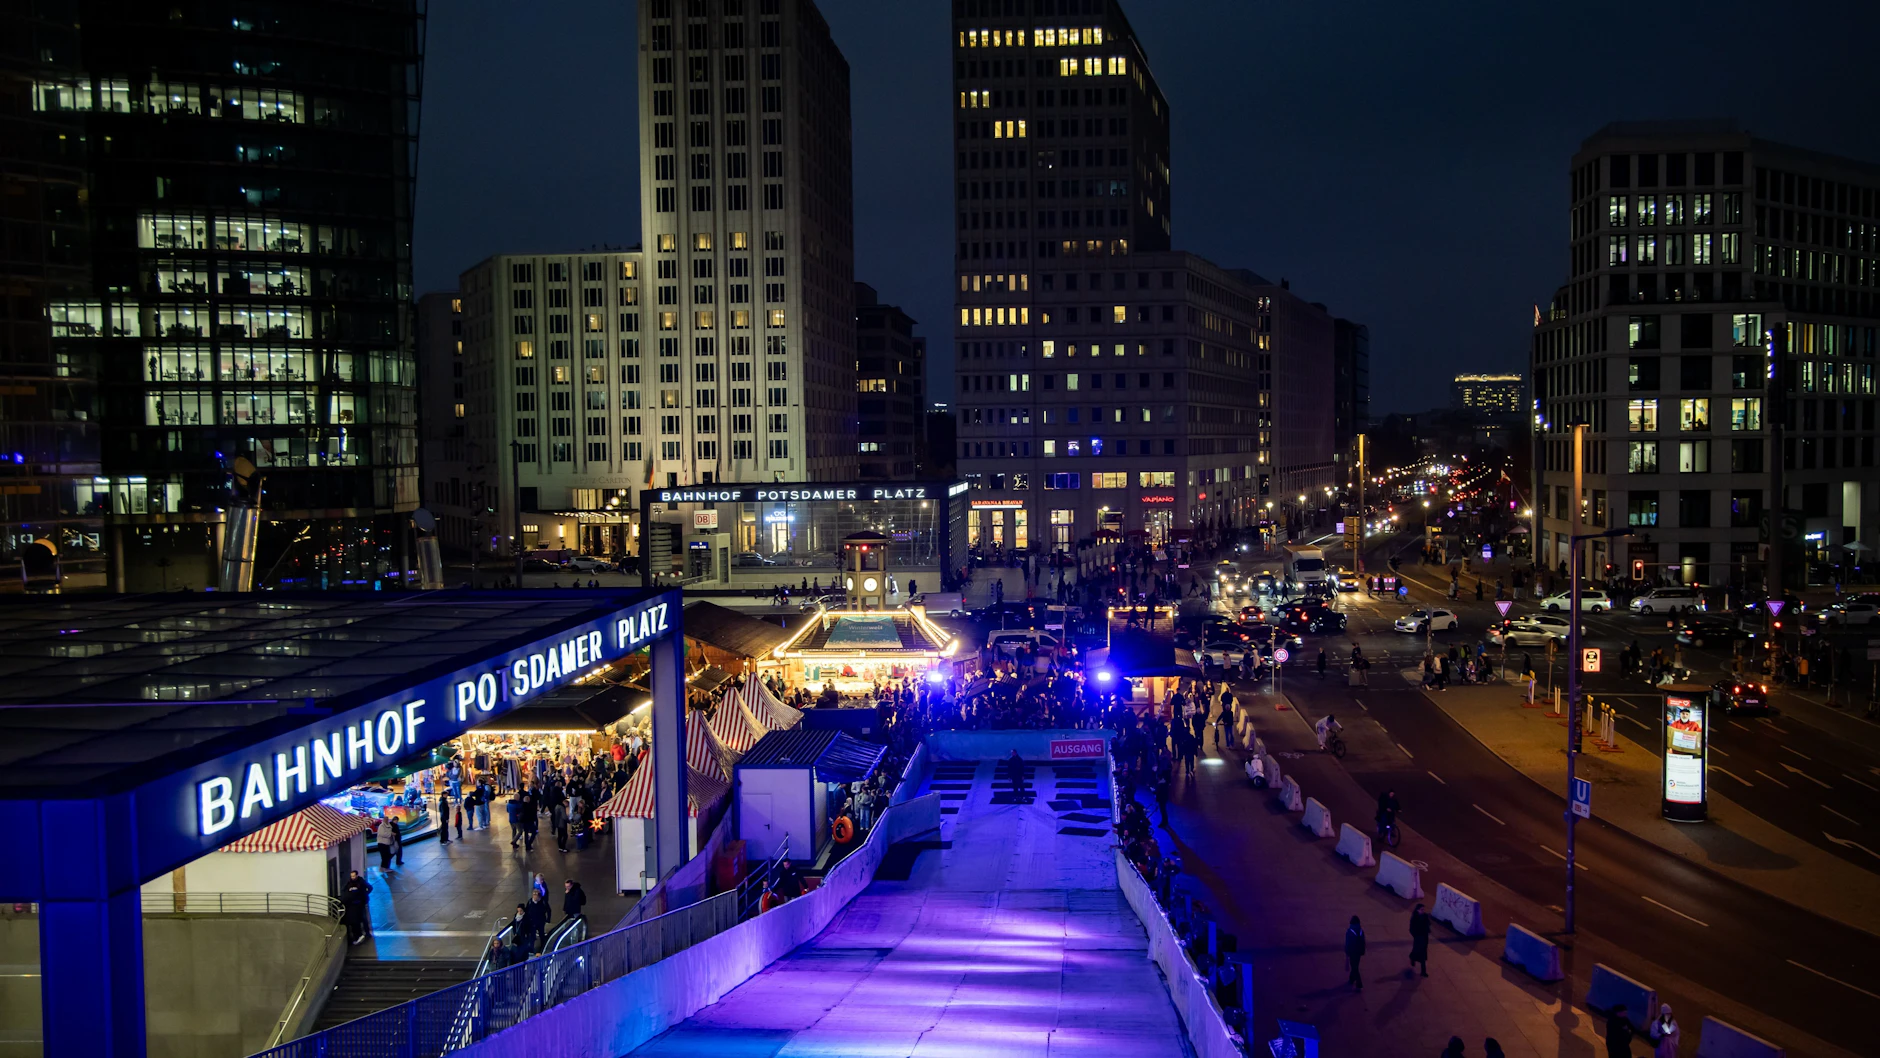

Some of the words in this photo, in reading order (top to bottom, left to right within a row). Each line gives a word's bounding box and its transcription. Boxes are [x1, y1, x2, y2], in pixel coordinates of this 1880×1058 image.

[660, 490, 741, 502] BAHNHOF
[757, 490, 857, 501] POTSDAMER
[874, 488, 926, 499] PLATZ
[200, 700, 426, 836] BAHNHOF
[456, 631, 603, 722] POTSDAMER
[618, 603, 668, 648] PLATZ
[1054, 744, 1102, 754] AUSGANG
[1576, 781, 1587, 801] U
